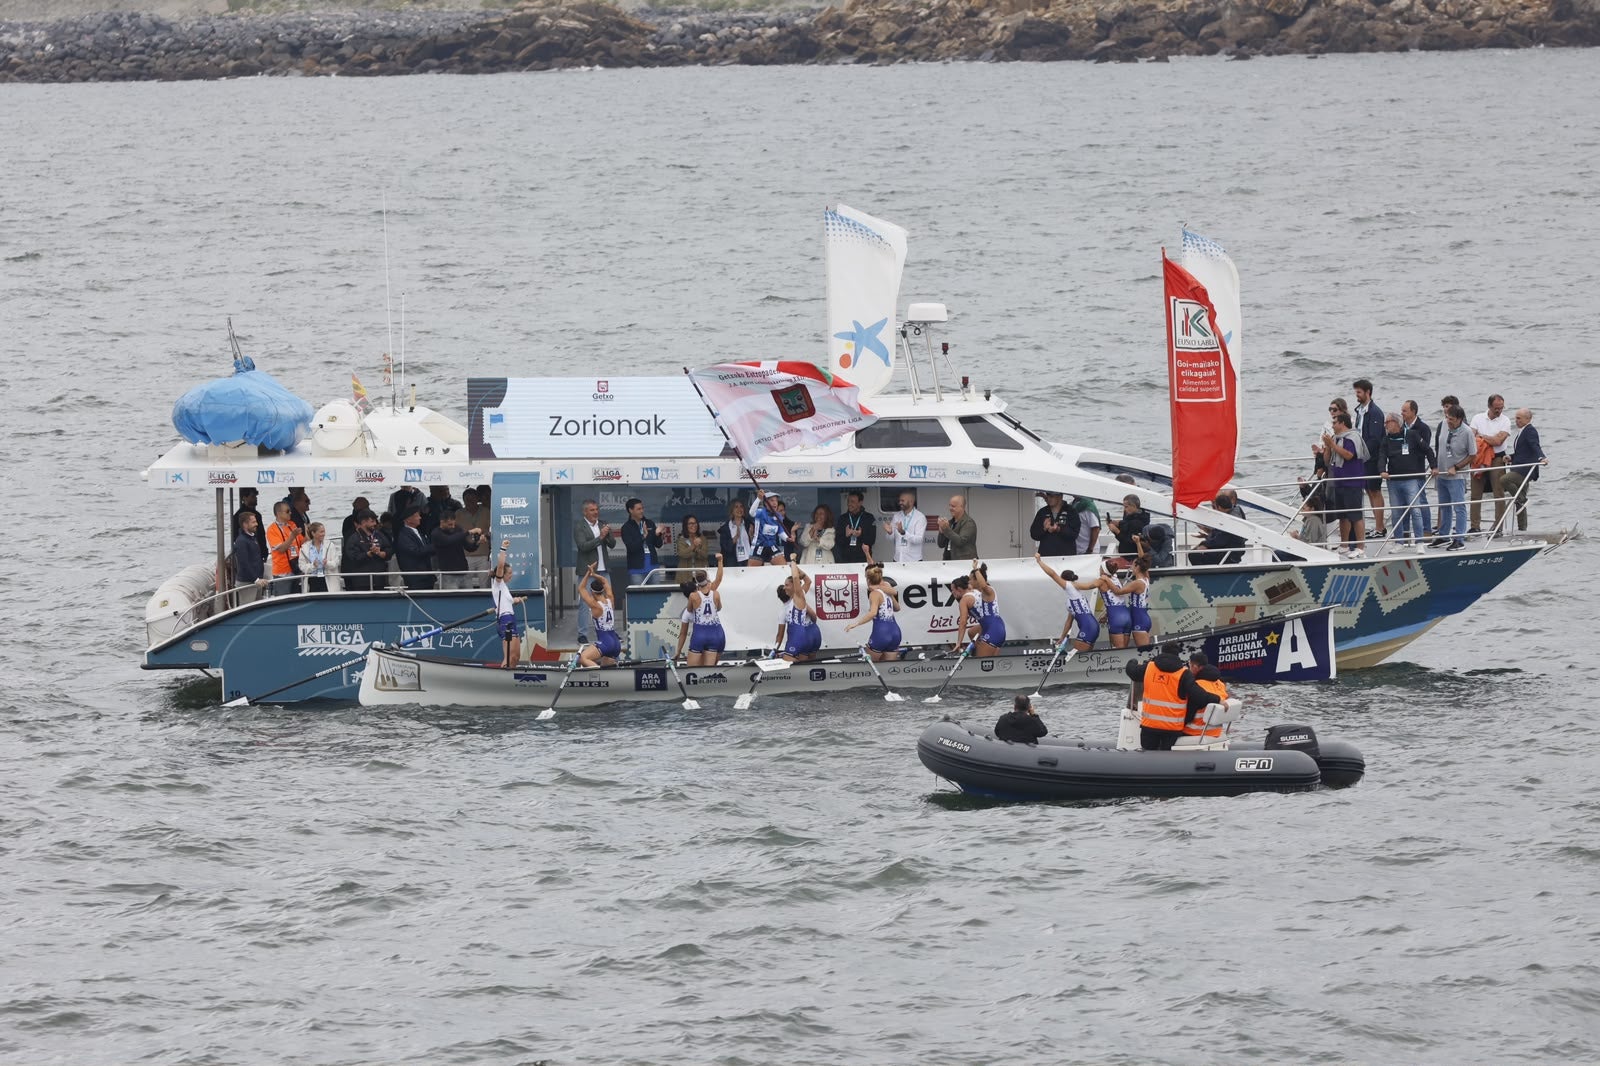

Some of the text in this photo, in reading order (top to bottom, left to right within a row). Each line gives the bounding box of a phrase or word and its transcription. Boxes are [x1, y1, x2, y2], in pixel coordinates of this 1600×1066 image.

[1176, 360, 1220, 368] Goi-mailako
[1181, 369, 1217, 379] elikagaiak
[549, 414, 666, 436] Zorionak
[812, 420, 846, 432] EUSKOTREN
[930, 615, 953, 628] bizi
[321, 631, 365, 645] LIGA
[439, 635, 474, 649] LIGA
[1219, 632, 1258, 646] ARRAUN
[1218, 640, 1263, 655] LAGUNAK
[1276, 618, 1318, 673] A
[1218, 648, 1267, 663] DONOSTIA
[829, 671, 872, 680] Edyma
[1280, 734, 1309, 742] SUZUKI
[1238, 759, 1269, 769] RPN
